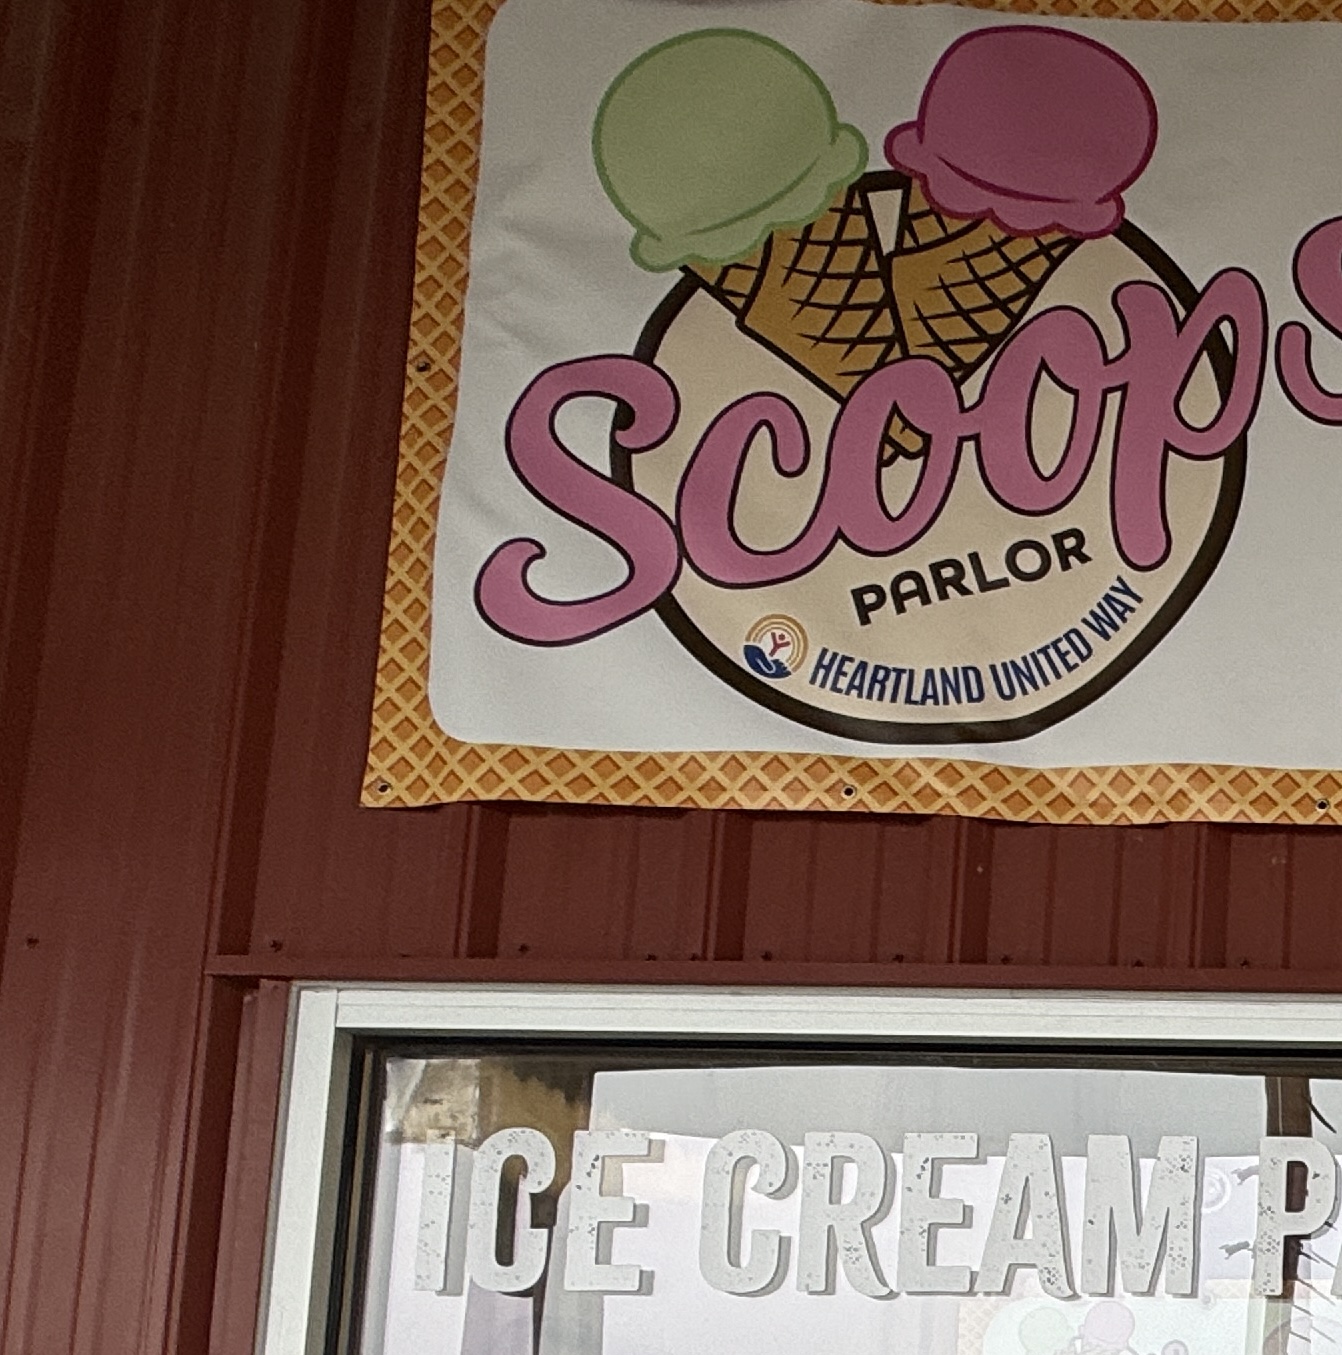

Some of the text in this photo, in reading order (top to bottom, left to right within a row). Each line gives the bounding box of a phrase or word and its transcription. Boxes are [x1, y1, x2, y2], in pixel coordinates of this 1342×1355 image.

[809, 575, 1144, 706] HEARTLAND UNITED WAY
[850, 528, 1092, 626] PARLOR
[412, 1127, 658, 1296] ICE
[698, 1127, 1199, 1299] CREAM
